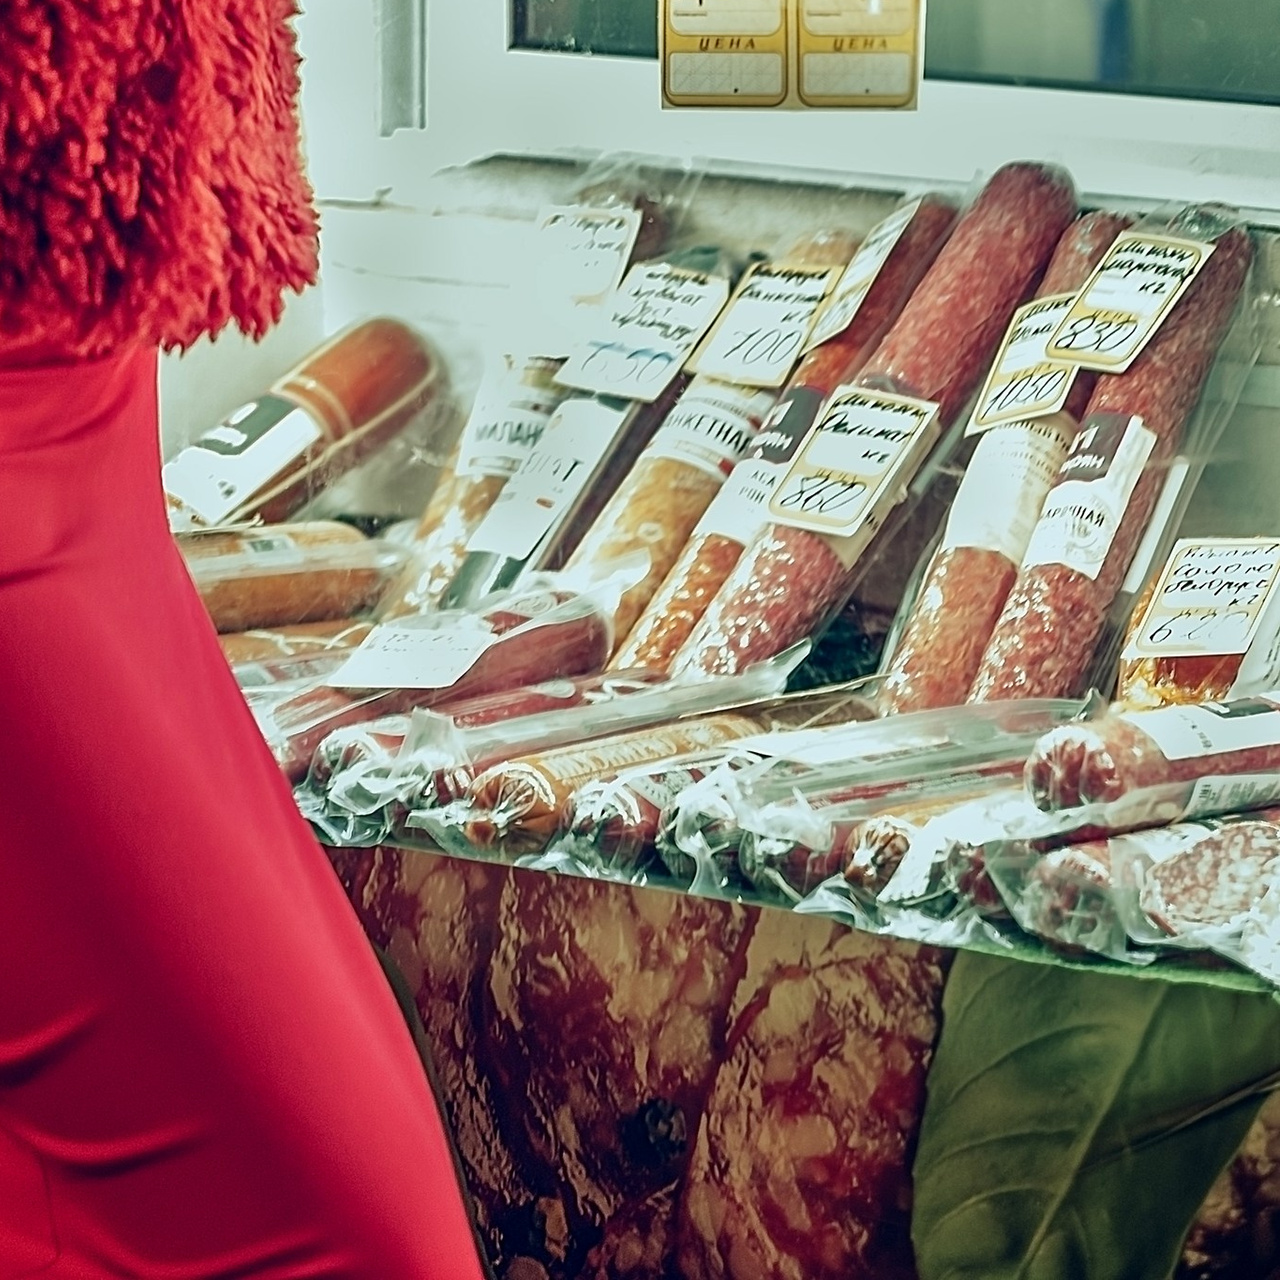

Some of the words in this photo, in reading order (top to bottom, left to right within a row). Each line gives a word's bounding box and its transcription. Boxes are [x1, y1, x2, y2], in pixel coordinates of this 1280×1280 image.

[699, 36, 756, 53] ЦЕНА
[833, 36, 889, 53] ЦЕНА
[723, 327, 803, 365] 700
[1054, 314, 1139, 353] 830
[980, 369, 1068, 420] 1050
[780, 475, 867, 514] 860
